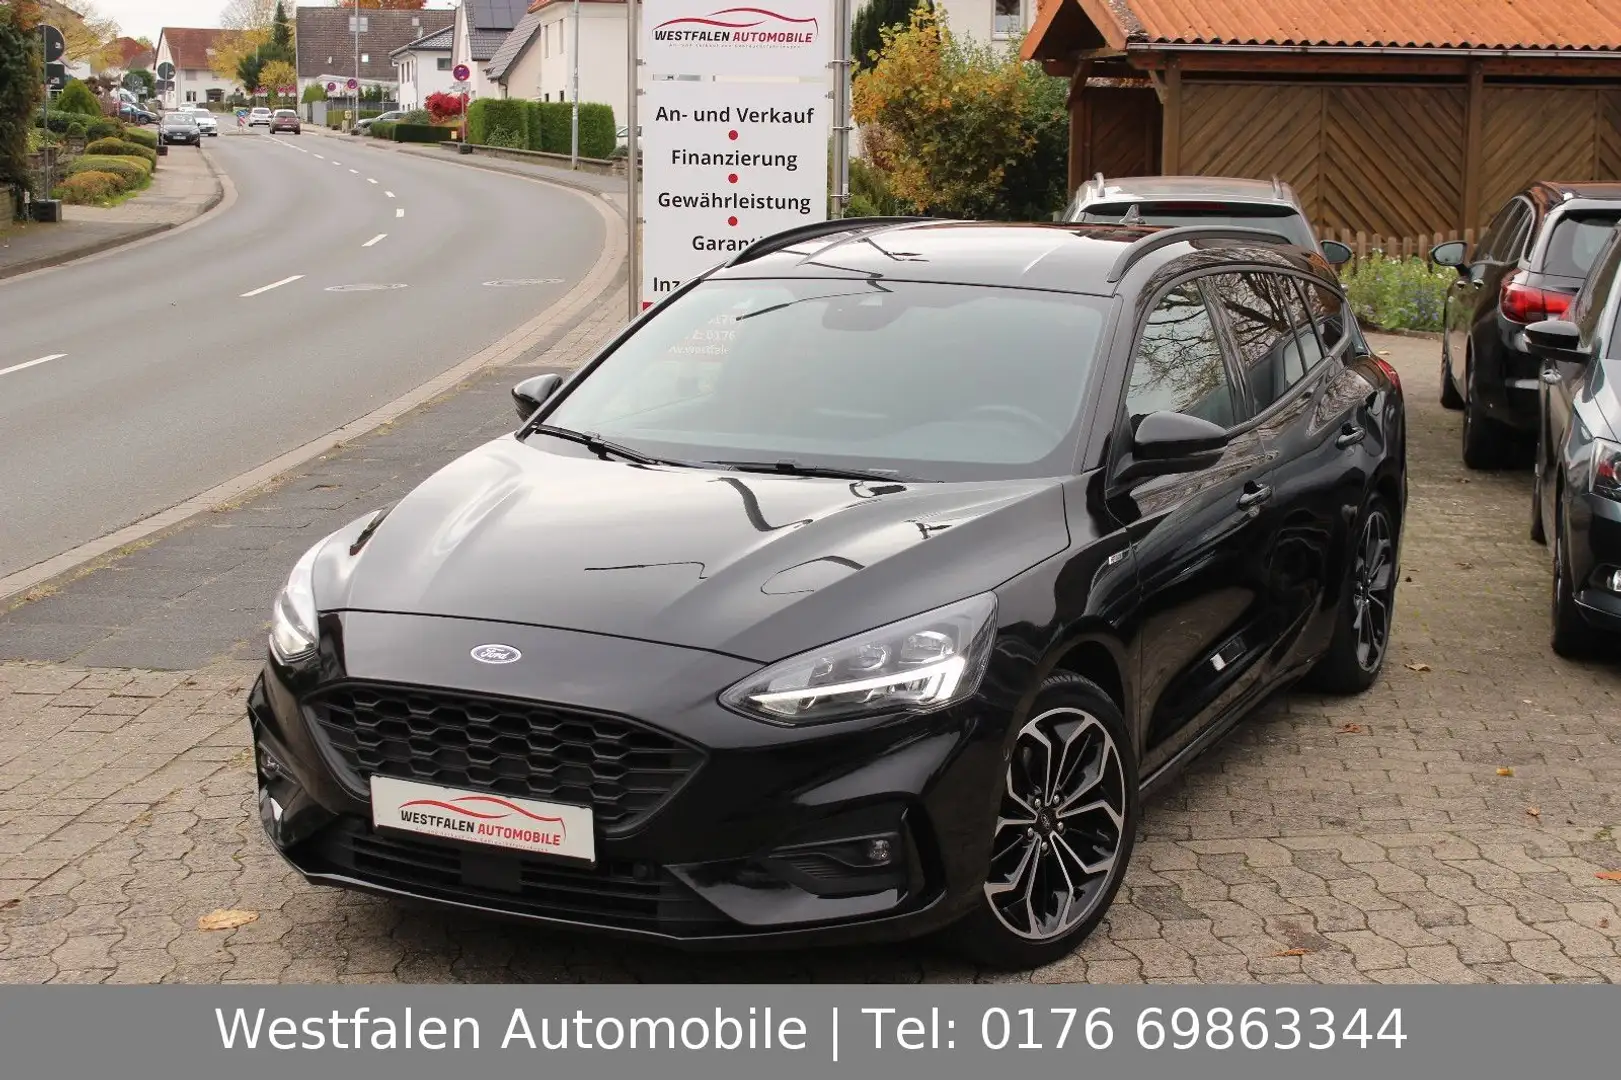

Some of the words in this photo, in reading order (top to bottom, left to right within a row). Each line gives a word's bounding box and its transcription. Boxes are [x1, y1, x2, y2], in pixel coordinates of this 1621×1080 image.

[654, 30, 730, 42] WESTFALEN
[732, 32, 813, 43] AUTOMOBILE
[655, 106, 688, 122] An-
[694, 106, 730, 123] und
[736, 107, 815, 124] Verkauf
[672, 148, 798, 171] Finanzierung
[658, 192, 811, 215] Gewährleistung
[401, 809, 475, 833] WESTFALEN
[477, 823, 561, 846] AUTOMOBILE
